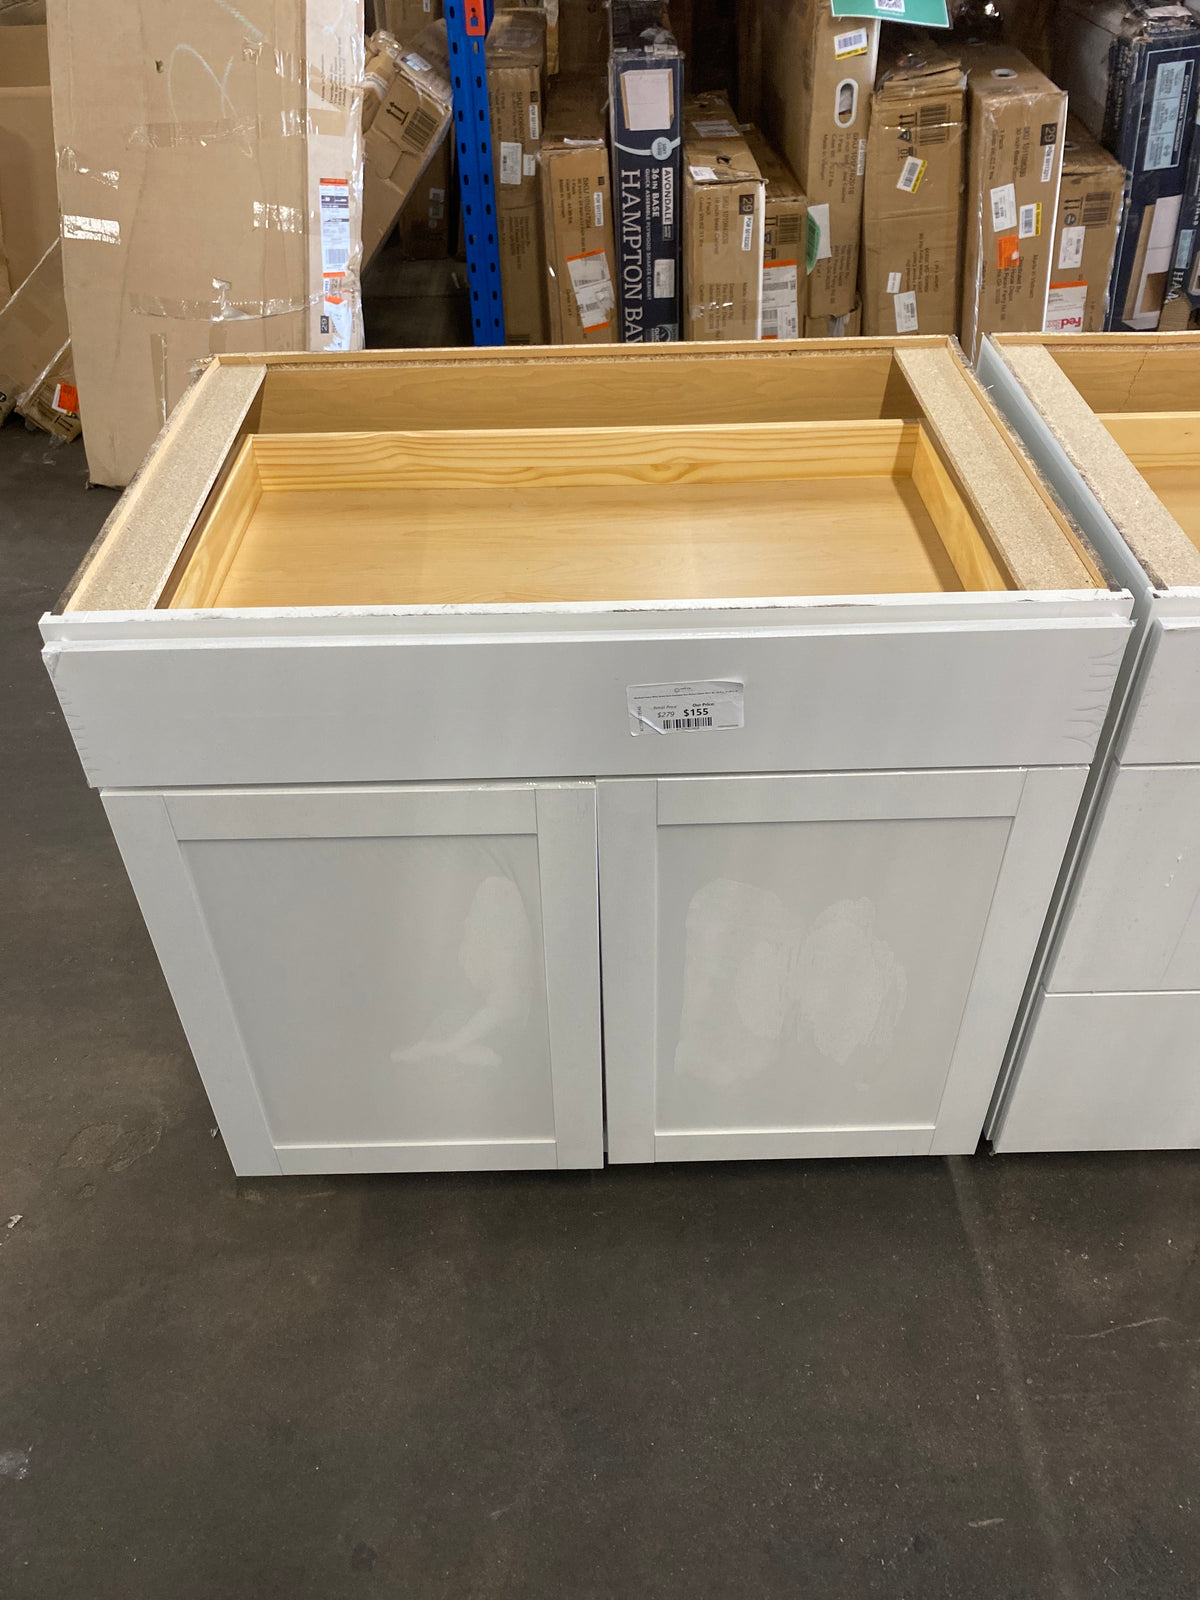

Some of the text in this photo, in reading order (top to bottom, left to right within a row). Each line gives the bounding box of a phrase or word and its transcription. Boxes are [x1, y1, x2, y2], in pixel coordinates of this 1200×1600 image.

[1044, 126, 1056, 142] 29
[652, 168, 659, 179] 36
[652, 181, 658, 189] IN
[664, 169, 672, 223] AVONDALE
[742, 197, 752, 212] 29
[621, 169, 642, 300] HAMPTON
[321, 318, 327, 331] 29
[684, 708, 709, 717] $155
